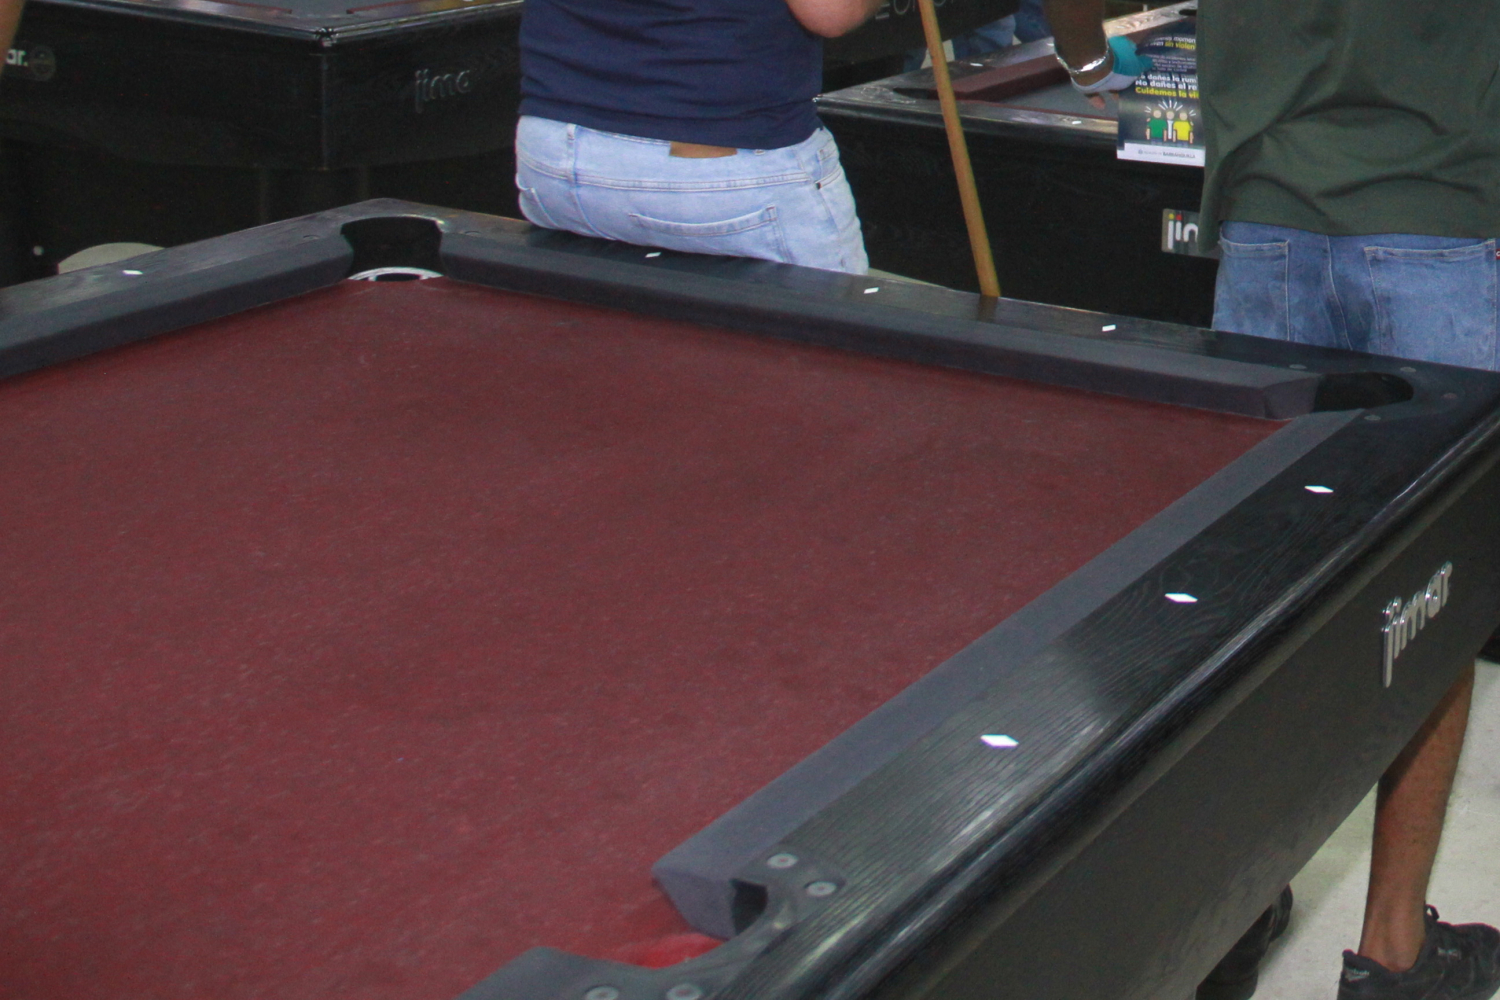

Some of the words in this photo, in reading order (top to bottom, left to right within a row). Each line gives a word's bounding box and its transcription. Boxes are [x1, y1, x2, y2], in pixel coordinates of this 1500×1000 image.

[1149, 80, 1177, 89] dañes
[1135, 86, 1177, 98] Cuidemos
[1178, 89, 1187, 98] la
[1381, 561, 1453, 688] jimar
